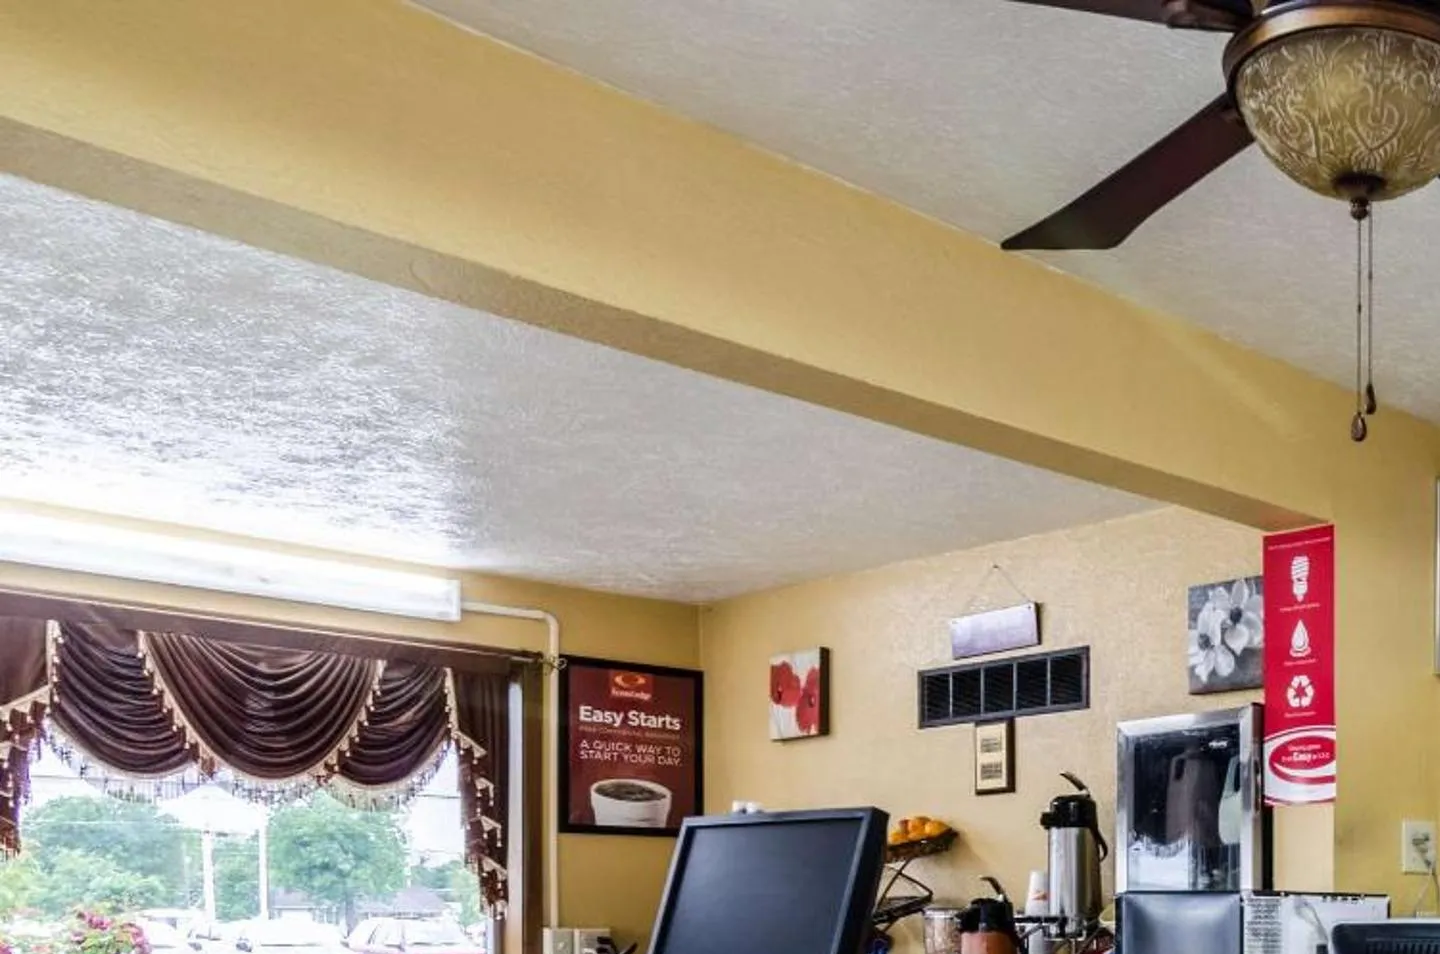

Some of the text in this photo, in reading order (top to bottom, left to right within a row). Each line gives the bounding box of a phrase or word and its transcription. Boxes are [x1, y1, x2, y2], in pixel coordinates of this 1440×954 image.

[579, 704, 682, 731] Easy Starts
[579, 749, 618, 761] START
[621, 752, 656, 764] YOUR
[580, 740, 682, 758] A QUICK WAY TO
